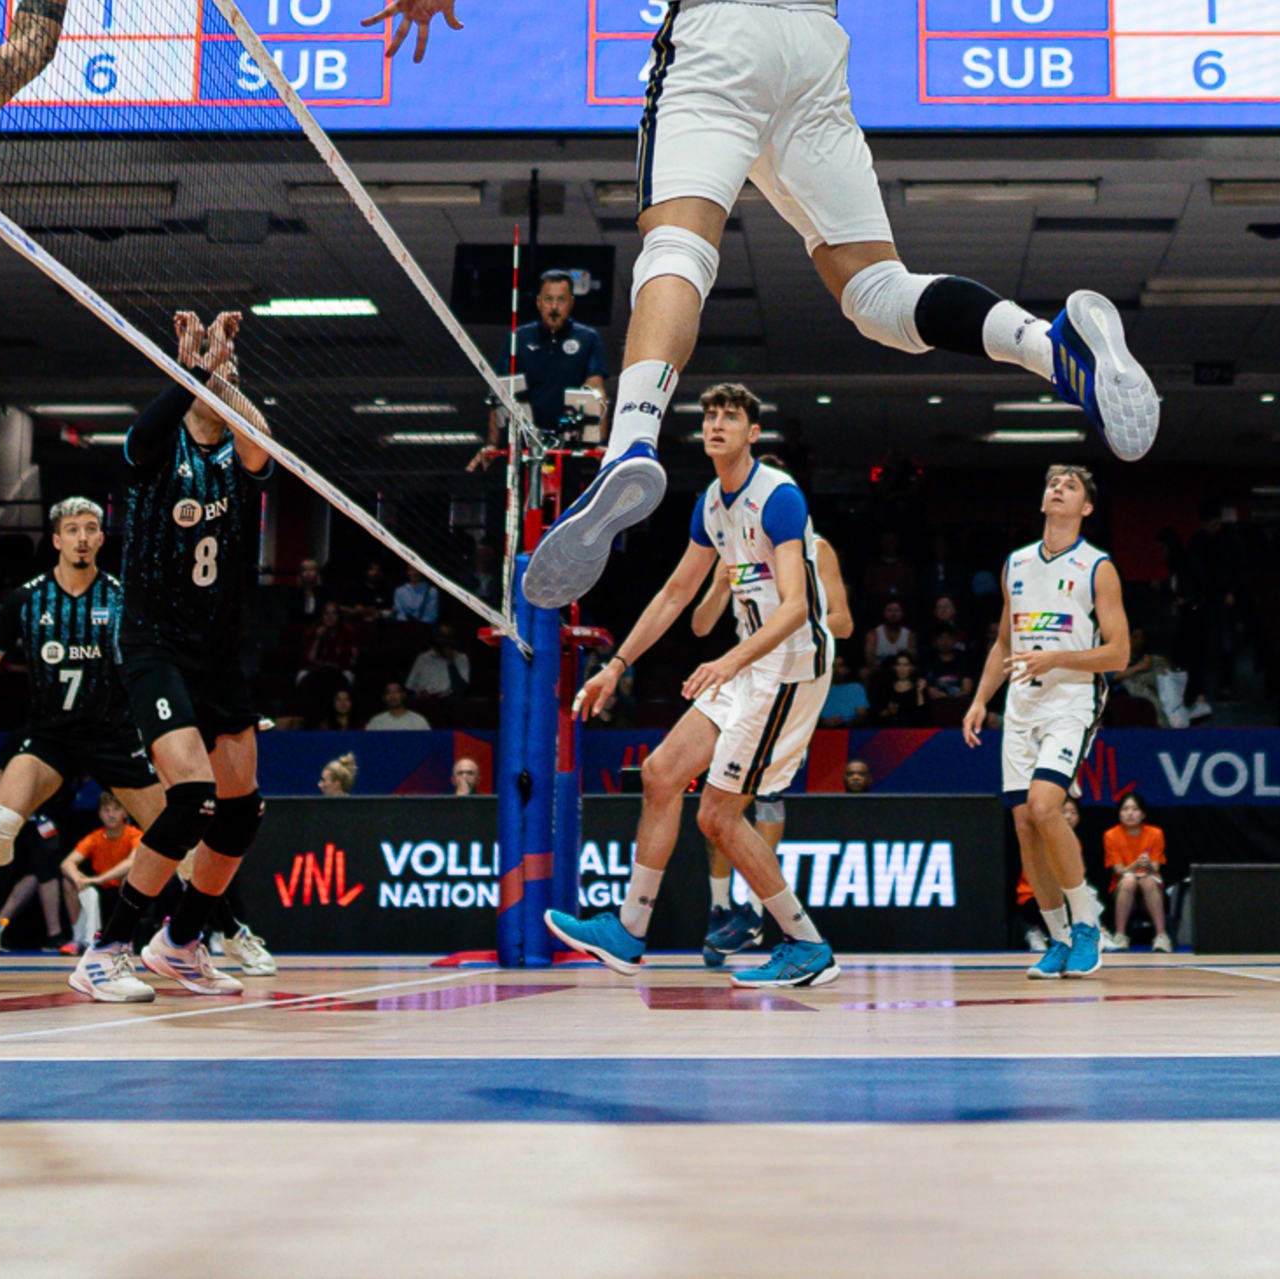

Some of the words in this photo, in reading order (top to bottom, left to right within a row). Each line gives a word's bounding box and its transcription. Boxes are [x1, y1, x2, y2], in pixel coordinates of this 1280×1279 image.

[84, 53, 118, 95] 6
[236, 49, 348, 91] SUB
[962, 47, 1074, 89] SUB
[1191, 49, 1228, 91] 6
[203, 496, 229, 522] BN
[191, 535, 218, 588] 8
[68, 645, 102, 660] BNA
[58, 669, 84, 711] 7
[155, 697, 172, 720] 8
[1076, 738, 1137, 803] NL
[274, 842, 365, 908] VNL
[378, 881, 501, 908] NATION
